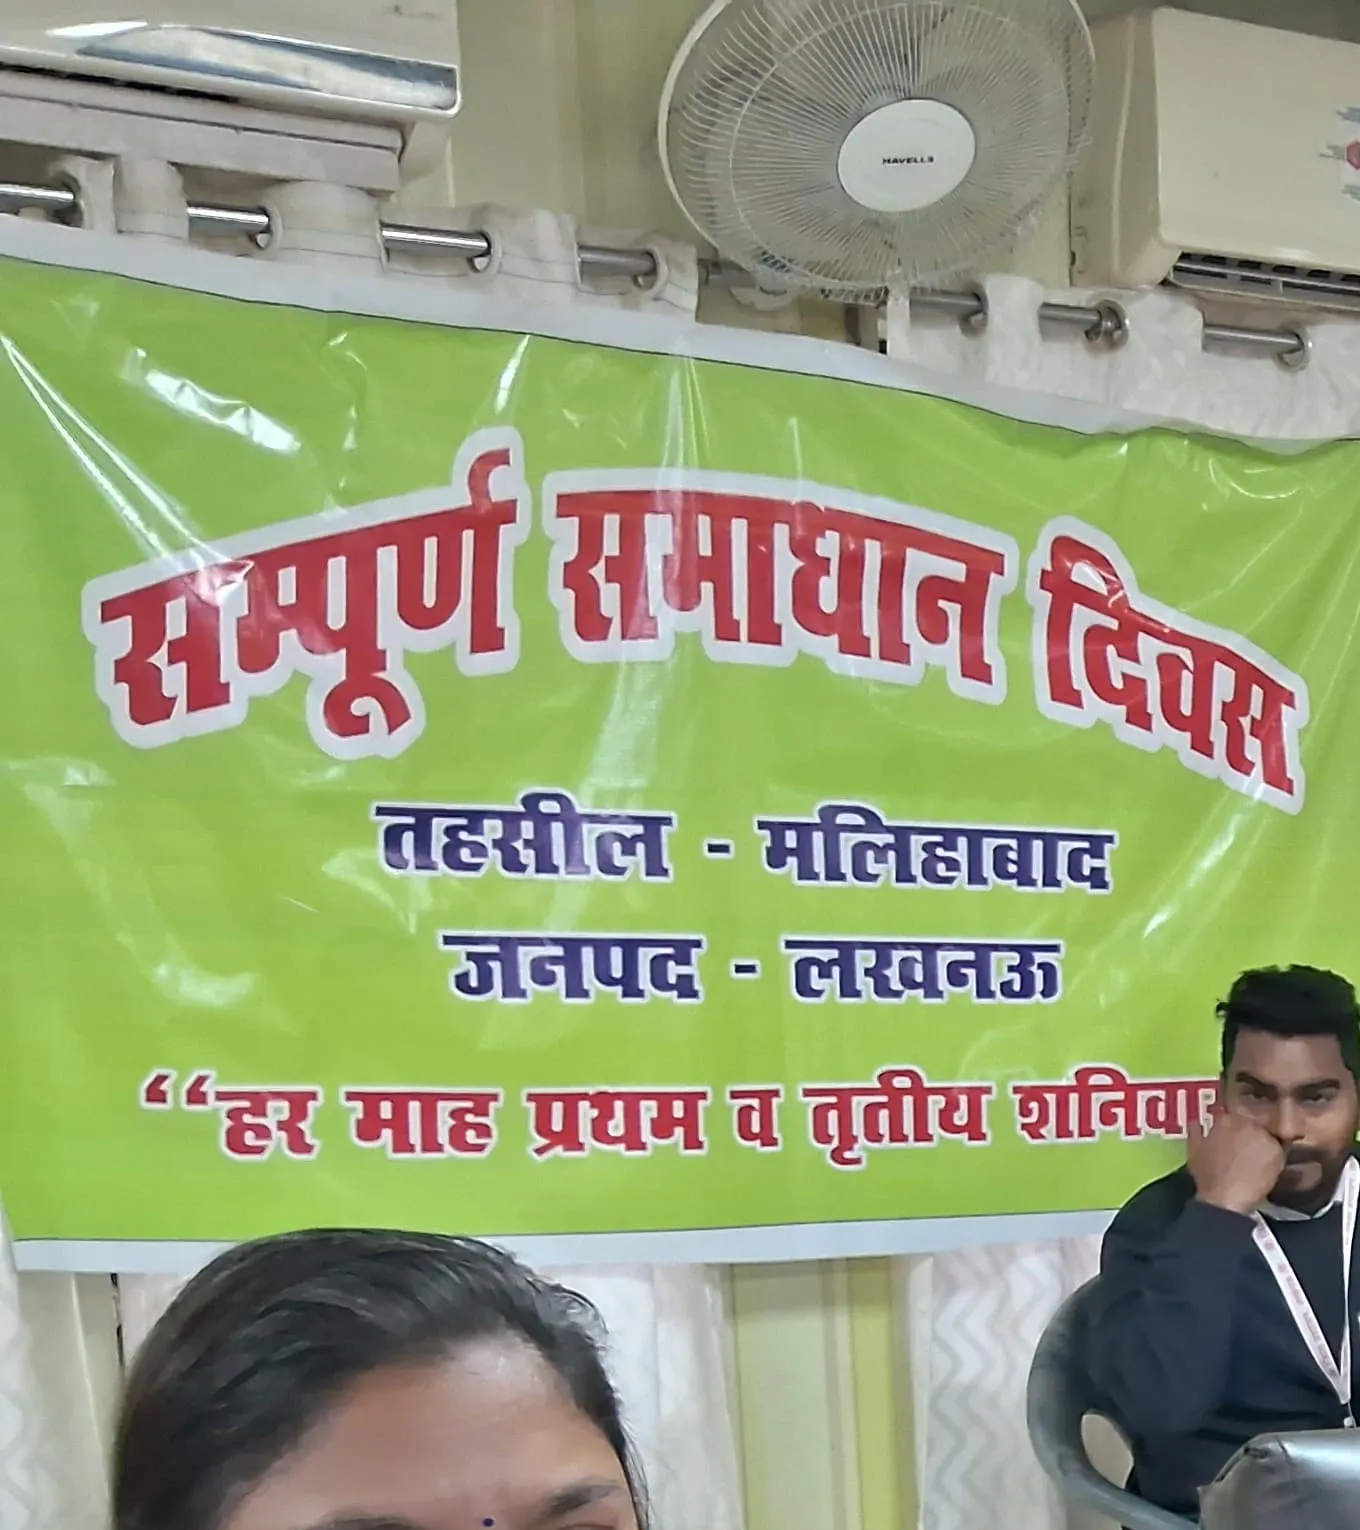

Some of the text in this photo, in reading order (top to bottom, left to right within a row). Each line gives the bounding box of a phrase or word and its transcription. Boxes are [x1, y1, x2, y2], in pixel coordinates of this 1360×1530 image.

[101, 450, 1294, 795] सम्पूर्ण समाधान दिवस
[377, 793, 673, 878] तहसील
[758, 806, 1116, 892] मलिहाबाद
[444, 934, 702, 1000] जनपद
[785, 939, 1062, 1001] लखनऊ
[346, 1091, 498, 1155] माह
[527, 1090, 708, 1156] प्रथम
[731, 1089, 781, 1148] व
[804, 1068, 990, 1166] तृतीय
